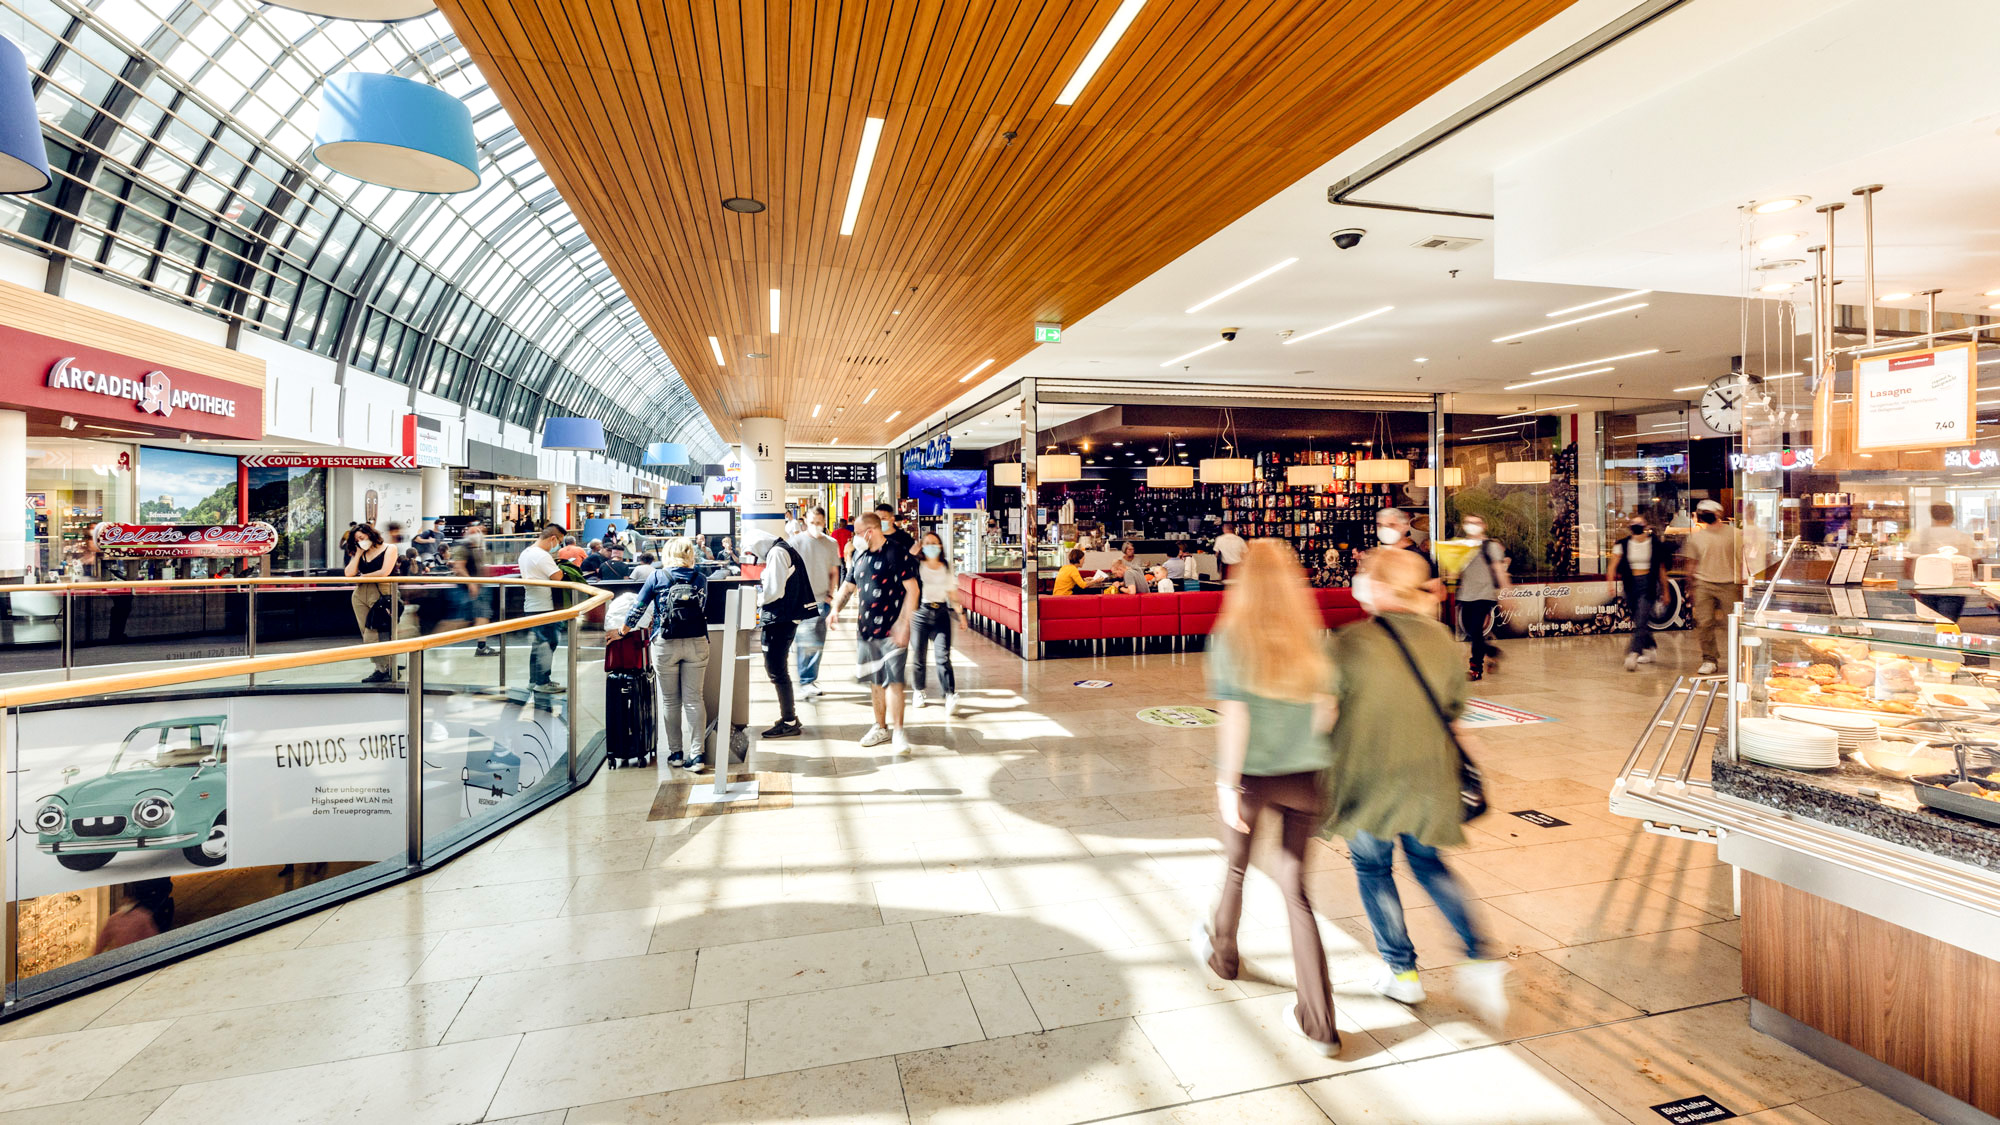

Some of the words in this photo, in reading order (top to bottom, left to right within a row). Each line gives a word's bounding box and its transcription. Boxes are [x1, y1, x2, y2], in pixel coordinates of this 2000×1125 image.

[48, 357, 145, 401] ARCADEN
[172, 389, 236, 418] APOTHEKE
[1870, 386, 1912, 398] Lasagne
[1935, 420, 1955, 431] 7,40
[267, 456, 320, 466] COVID-19
[320, 456, 386, 467] TESTCENTER
[788, 467, 795, 478] 1
[99, 526, 187, 545] Gelato
[188, 530, 202, 543] e
[143, 549, 193, 557] MOMENTI
[1498, 588, 1534, 600] Gelato
[1575, 605, 1597, 615] Coffee
[1598, 605, 1605, 614] to
[1528, 623, 1550, 632] Coffee
[1551, 623, 1559, 631] to
[275, 737, 347, 768] ENDLOS
[359, 734, 409, 761] SURFE
[315, 786, 339, 794] Nutze
[340, 786, 390, 795] unbegrenztes
[311, 796, 354, 806] Highspeed
[355, 796, 380, 804] WLAN
[312, 807, 330, 815] dem
[332, 806, 393, 816] Treueprogramm.
[1660, 1105, 1686, 1115] Bitte
[1680, 1100, 1712, 1110] halten
[1673, 1115, 1691, 1124] Sie
[1687, 1106, 1726, 1121] Abstand!
